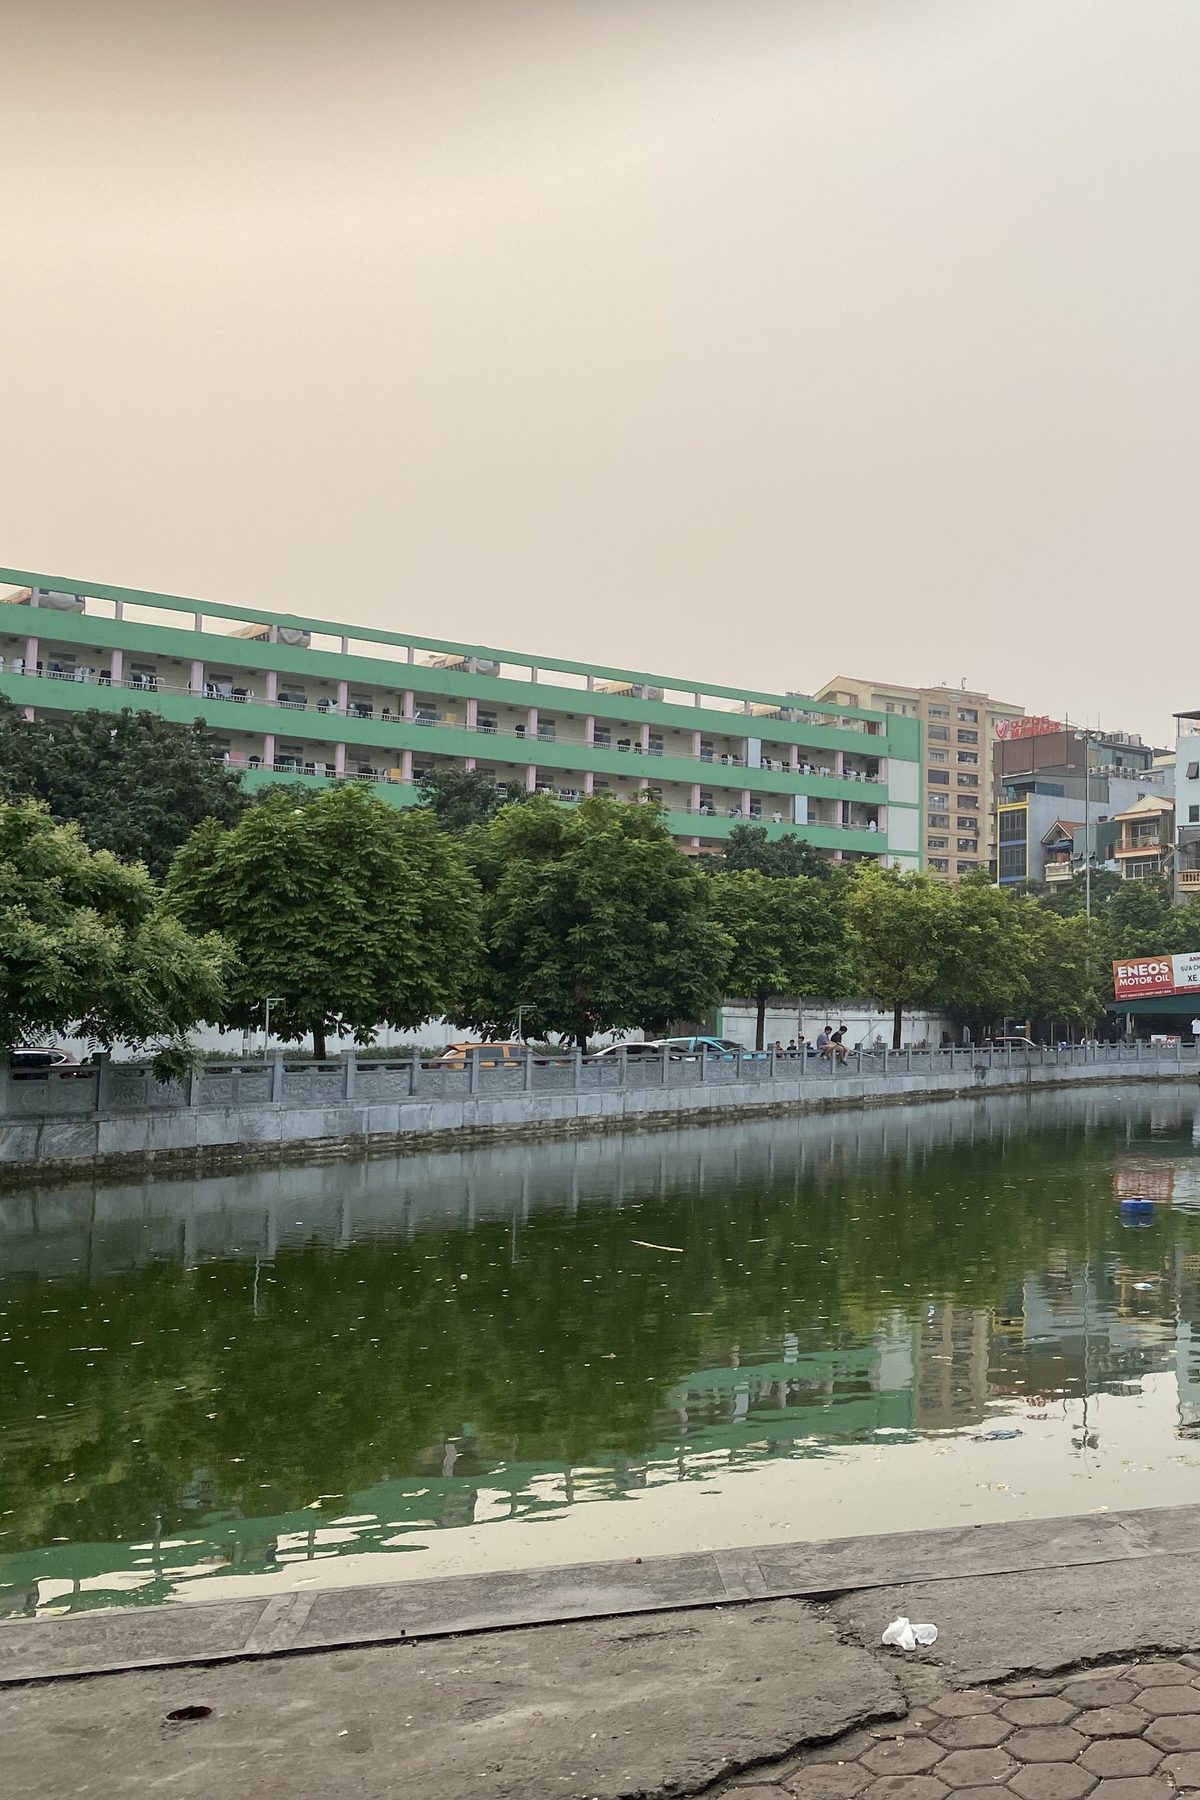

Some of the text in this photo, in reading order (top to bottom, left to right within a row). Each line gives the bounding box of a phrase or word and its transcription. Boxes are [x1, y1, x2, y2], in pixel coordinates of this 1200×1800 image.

[1117, 961, 1169, 978] ENEOS
[1119, 974, 1170, 987] MOTOR OIL
[1187, 974, 1198, 982] XE
